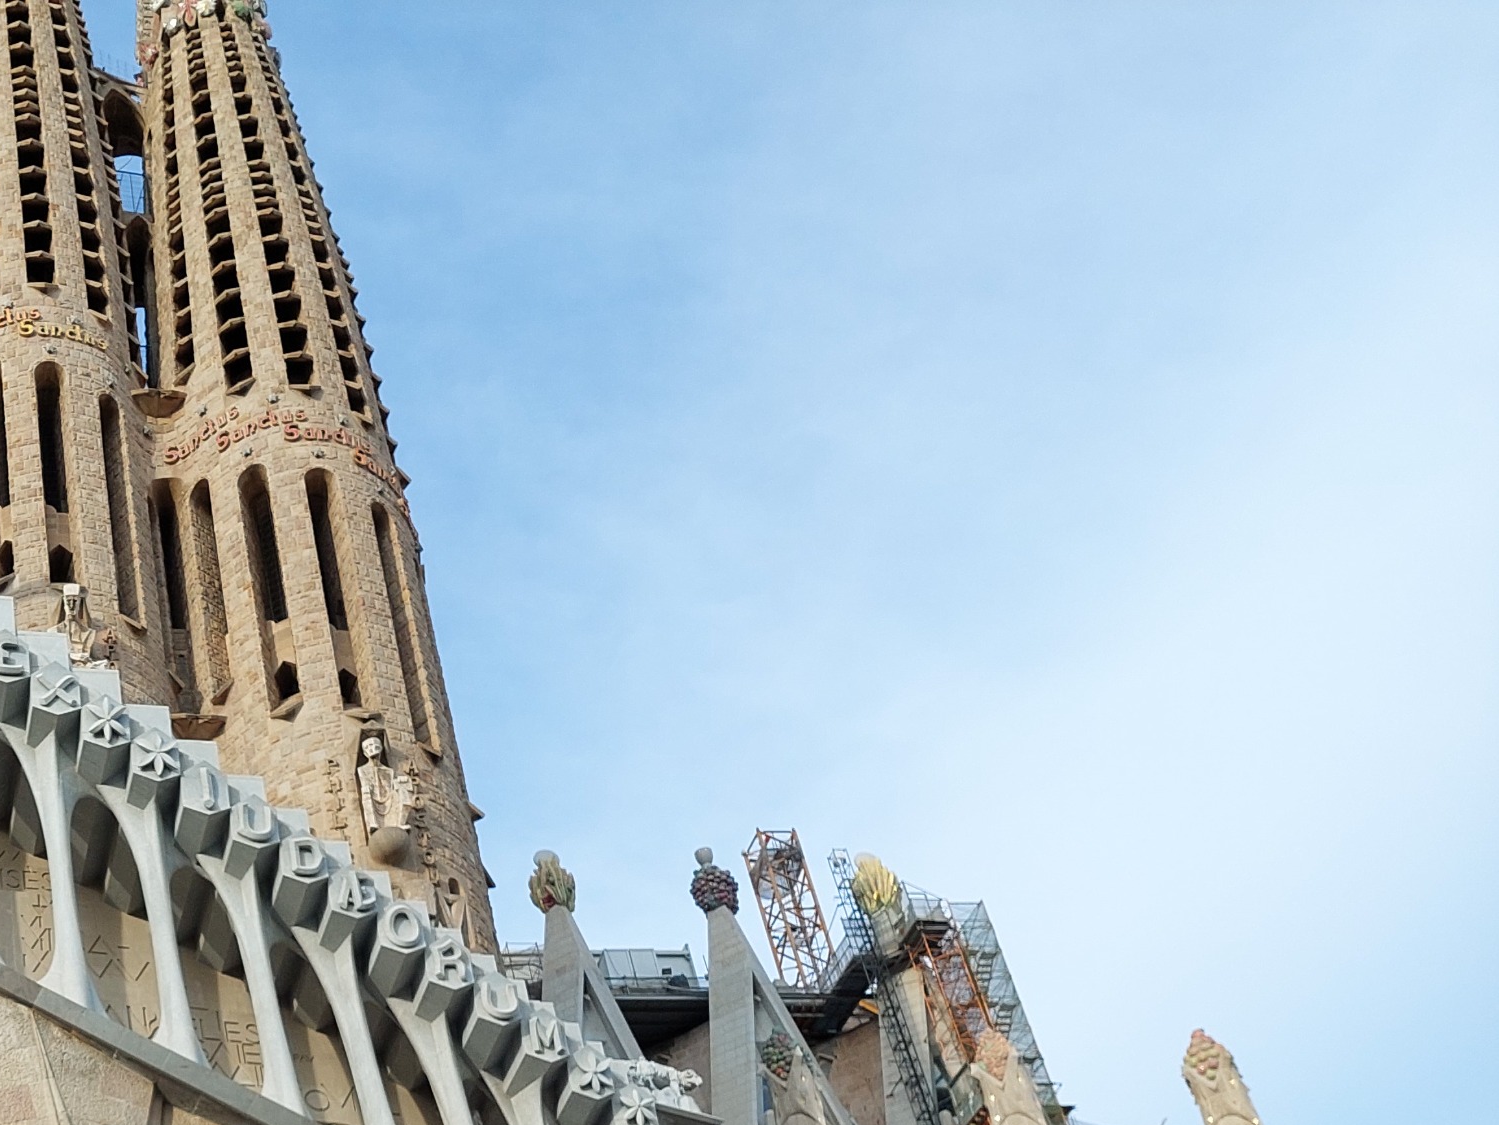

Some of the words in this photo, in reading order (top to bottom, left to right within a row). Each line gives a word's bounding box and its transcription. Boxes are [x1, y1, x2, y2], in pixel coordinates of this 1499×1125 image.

[18, 319, 109, 350] Sanctus
[164, 406, 240, 464] Sanctus
[216, 409, 307, 453] Sanctus
